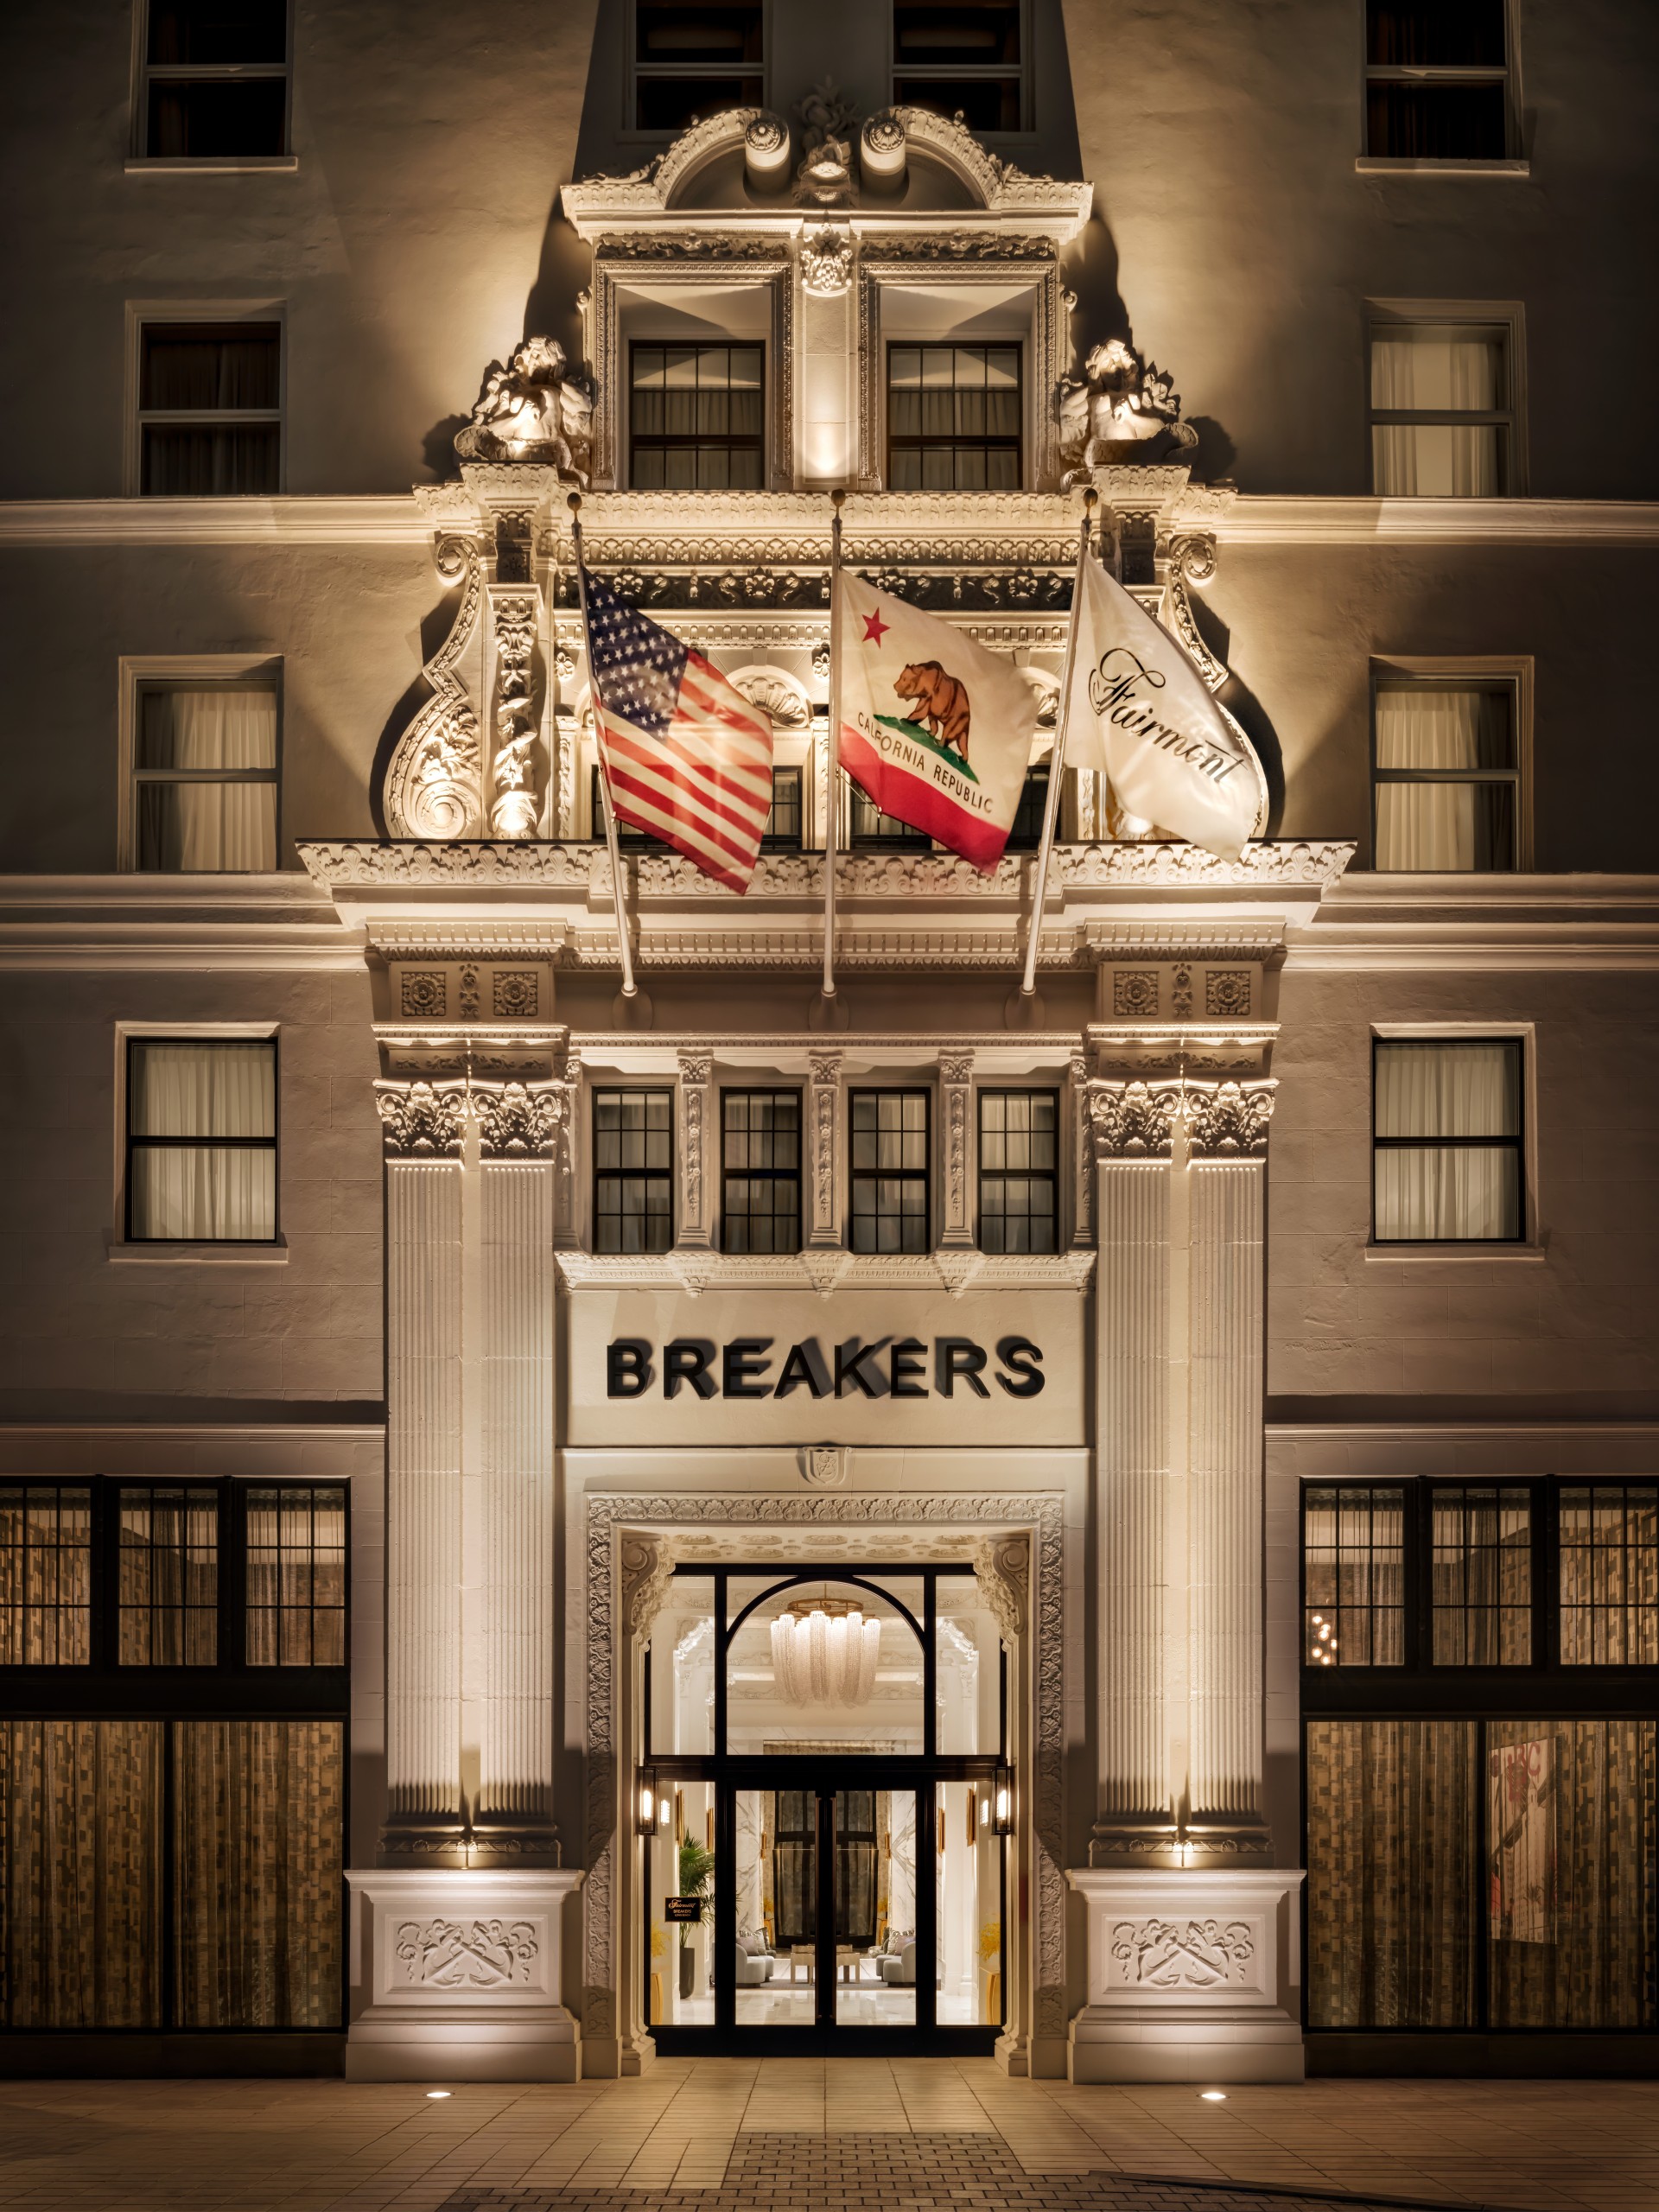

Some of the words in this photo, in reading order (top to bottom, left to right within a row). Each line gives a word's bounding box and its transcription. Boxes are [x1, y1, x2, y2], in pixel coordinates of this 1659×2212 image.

[1088, 647, 1248, 783] Fairmont
[857, 711, 925, 772] CALFORNIA
[933, 764, 994, 814] REPUBLIC
[607, 1343, 1046, 1400] BREAKERS
[668, 1898, 696, 1909] Fairmont
